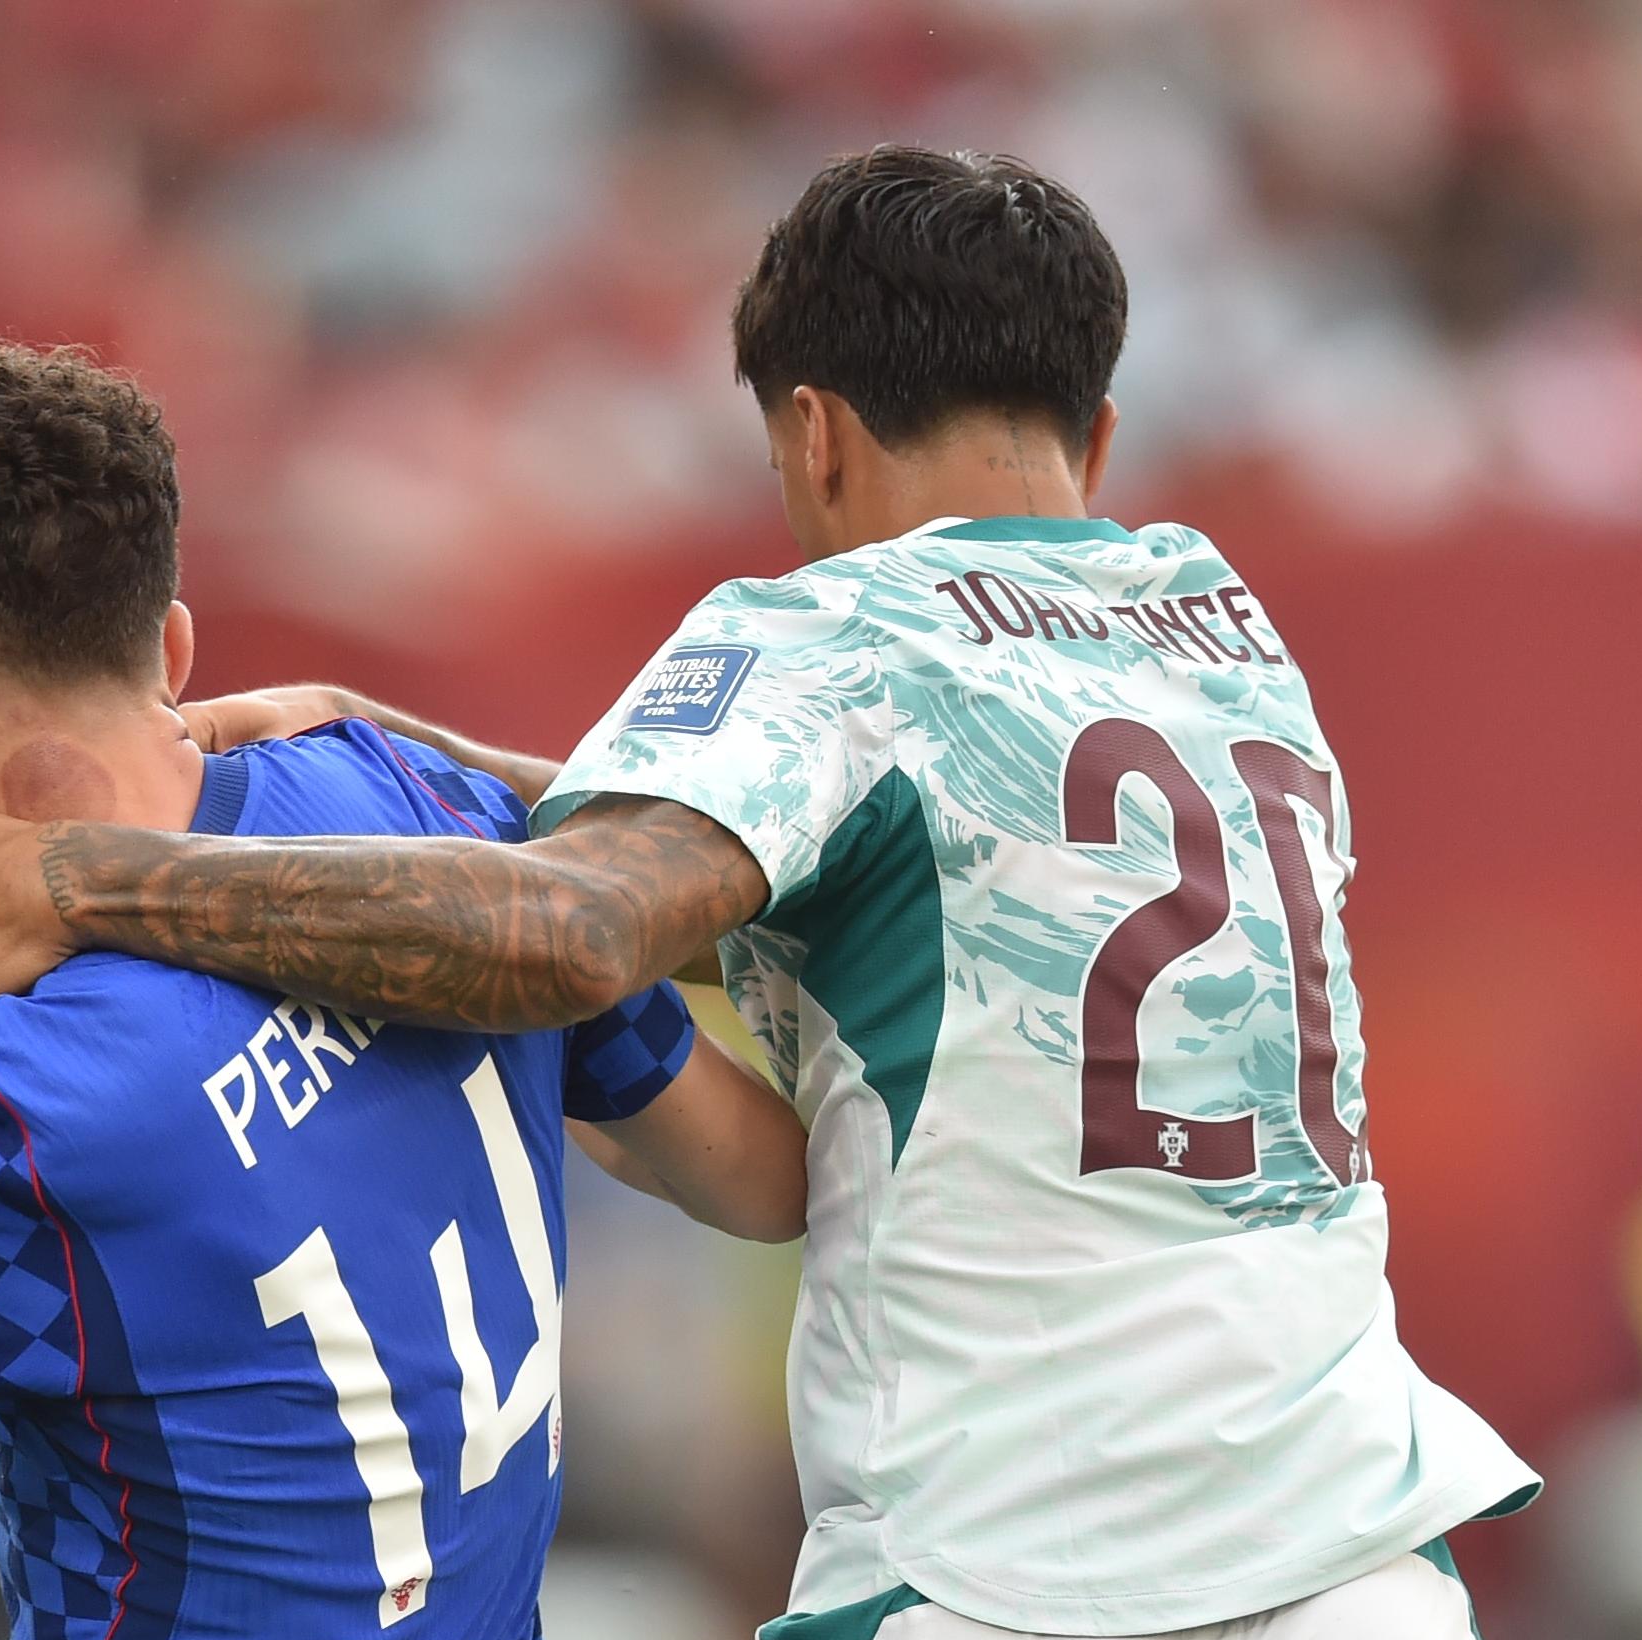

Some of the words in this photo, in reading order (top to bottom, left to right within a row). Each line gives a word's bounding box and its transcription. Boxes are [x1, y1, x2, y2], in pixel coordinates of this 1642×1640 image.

[643, 706, 677, 717] FIFA
[657, 656, 727, 675] OOTBALL
[1062, 716, 1369, 1189] 20
[201, 994, 387, 1171] PERI
[253, 1051, 563, 1630] 14
